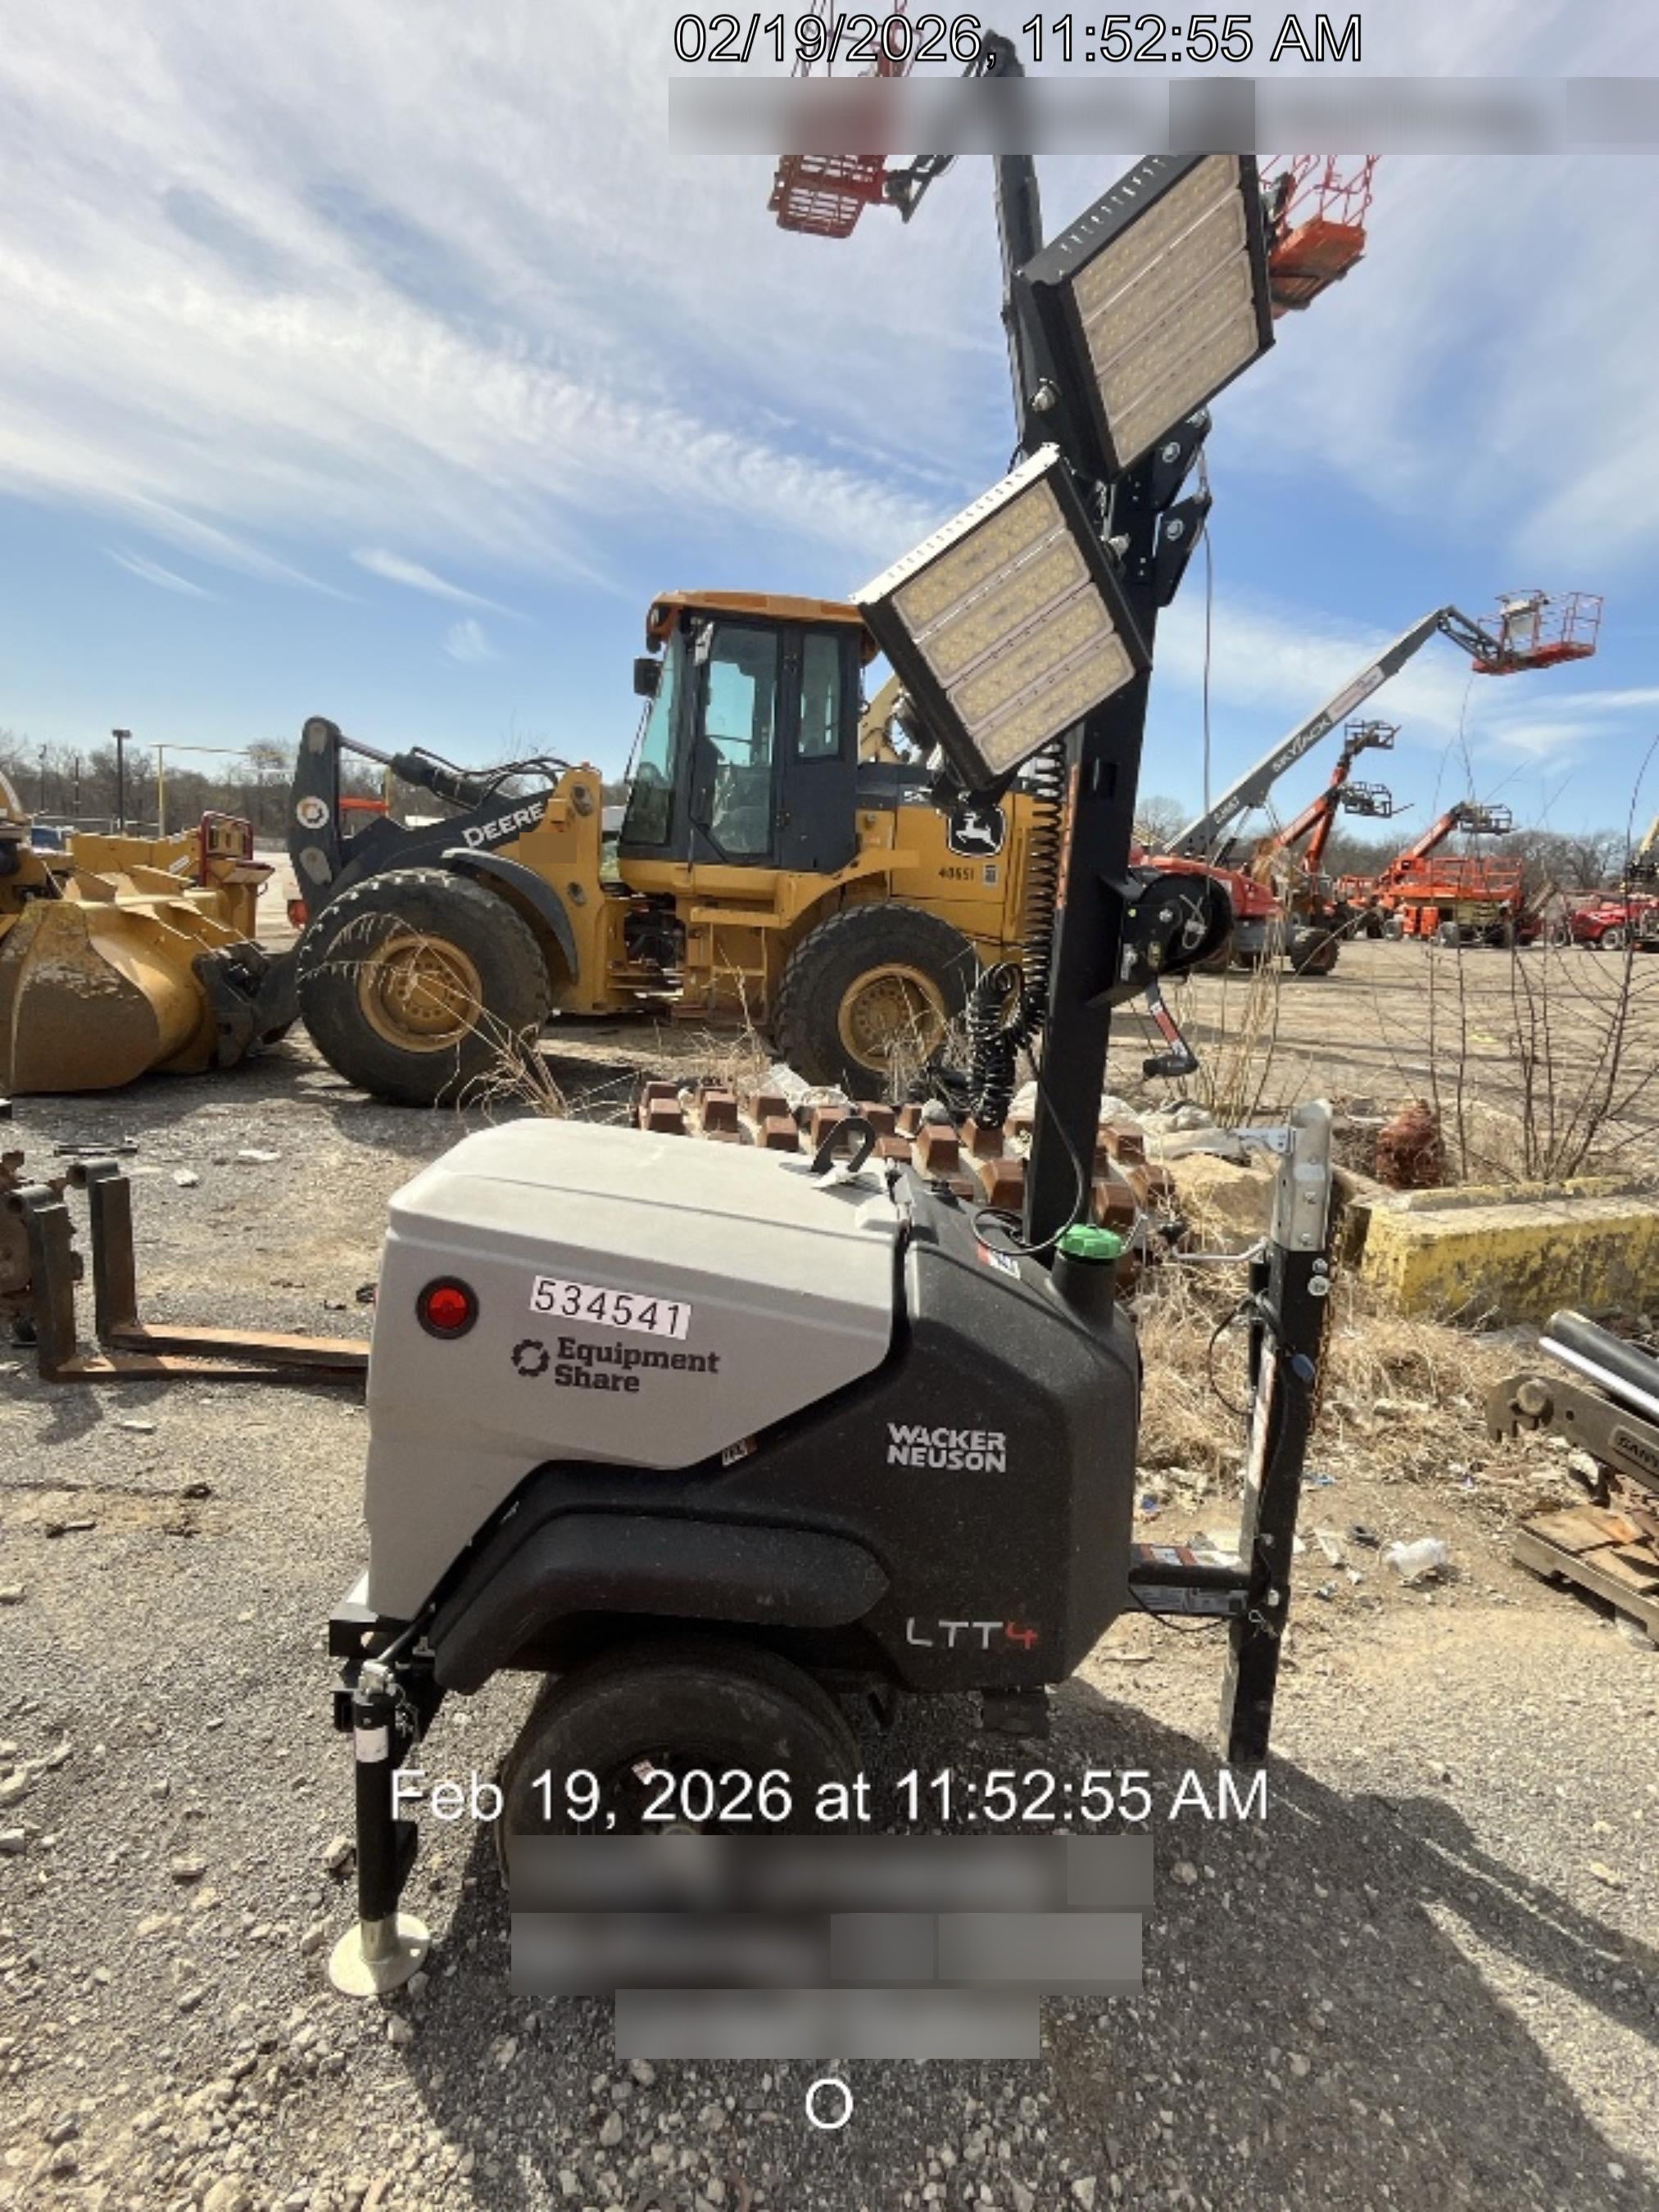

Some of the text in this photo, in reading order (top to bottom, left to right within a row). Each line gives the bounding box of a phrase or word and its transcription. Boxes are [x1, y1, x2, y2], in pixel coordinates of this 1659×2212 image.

[461, 802, 546, 848] DEERE
[534, 1280, 679, 1335] 534541
[557, 1336, 721, 1374] Equipment
[555, 1363, 640, 1393] Share
[886, 1421, 1007, 1452] WACKER
[886, 1444, 1007, 1474] NEUSON
[906, 1616, 1037, 1650] LTT4
